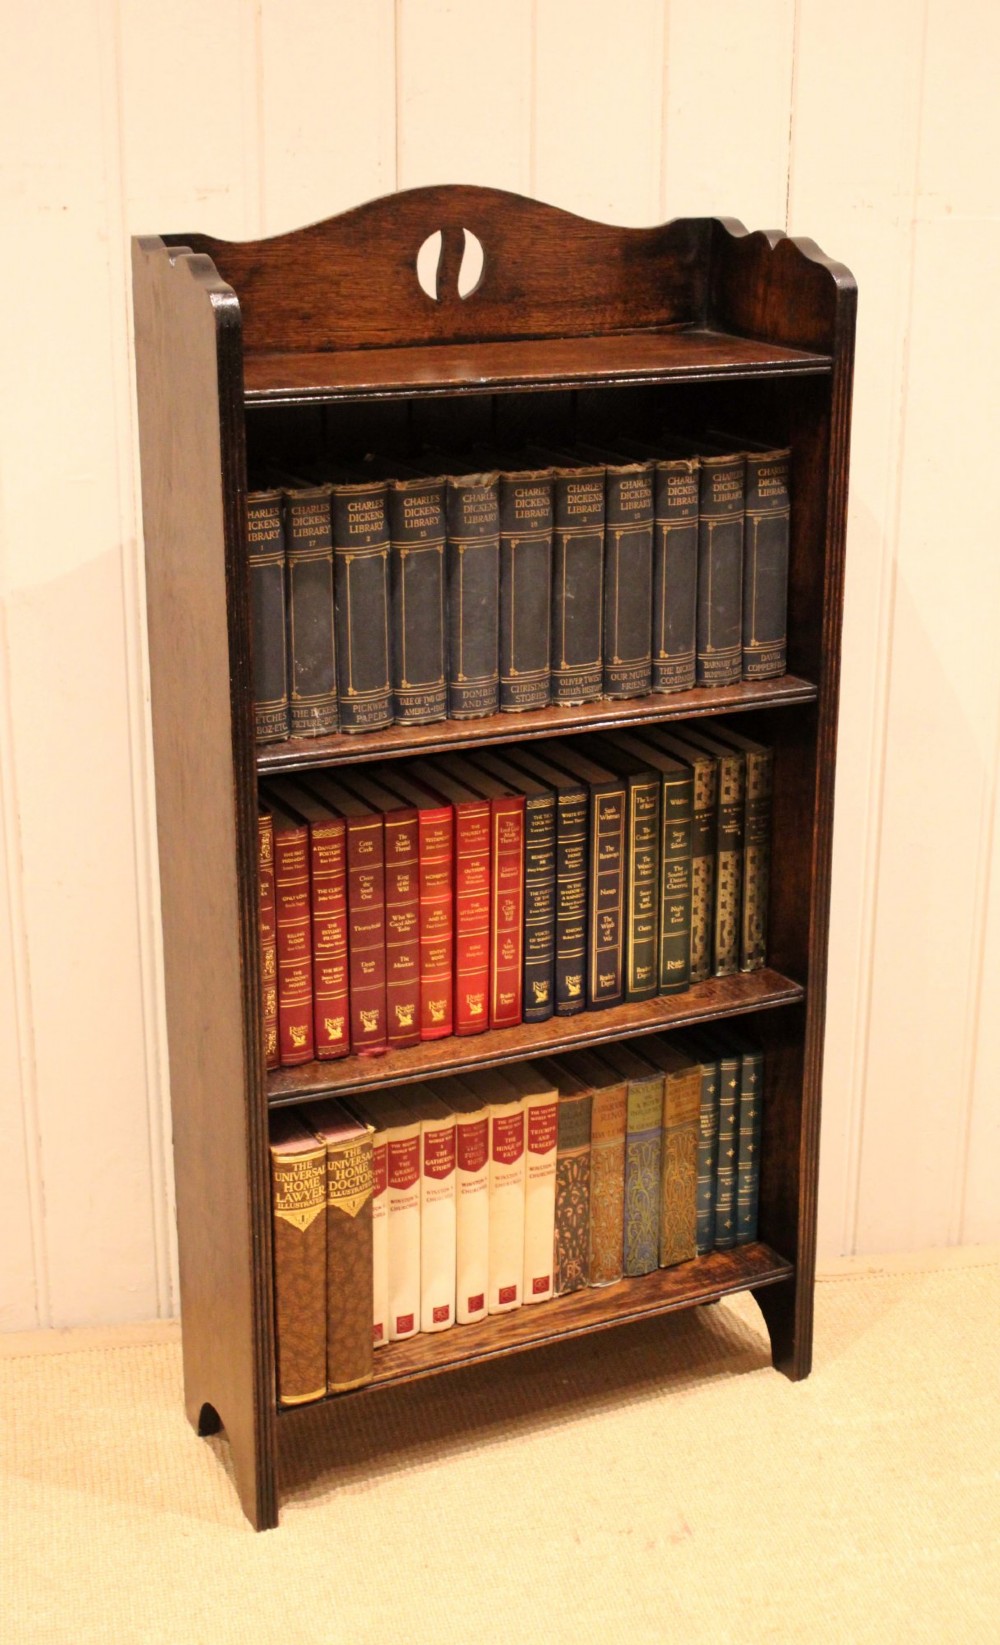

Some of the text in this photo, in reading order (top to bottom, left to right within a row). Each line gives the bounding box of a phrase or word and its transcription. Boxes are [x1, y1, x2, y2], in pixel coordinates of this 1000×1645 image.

[758, 466, 787, 477] CHARL
[668, 476, 696, 486] CHARL
[758, 477, 786, 488] DICKE
[515, 486, 550, 498] CHARLES
[567, 482, 602, 494] CHARLES
[404, 494, 440, 507] CHARLES
[568, 493, 603, 504] DICKENS
[620, 489, 652, 500] DICKENS
[348, 500, 384, 512] CHARLES
[464, 502, 498, 514] DICKENS
[516, 497, 550, 508] DICKENS
[568, 503, 603, 514] LIBRARY
[247, 507, 280, 519] HARLES
[291, 503, 330, 515] CHARLES
[404, 506, 440, 518] DICKENS
[516, 508, 550, 519] LIBRARY
[292, 514, 331, 526] DICKENS
[348, 511, 384, 523] DICKENS
[405, 517, 440, 529] LIBRARY
[464, 512, 498, 524] LIBRARY
[248, 518, 280, 530] ICKENS
[350, 521, 384, 534] LIBRARY
[248, 529, 280, 541] IBRARY
[293, 525, 331, 537] LIBRARY
[611, 672, 628, 680] OUR
[622, 680, 646, 690] FRIEND
[462, 688, 496, 698] DOMBEY
[516, 692, 546, 703] STORIES
[353, 701, 388, 712] PICKWICK
[462, 700, 481, 708] AND
[294, 710, 308, 718] THE
[356, 711, 387, 722] PAPERS
[344, 1147, 362, 1158] THE
[294, 1161, 312, 1172] THE
[328, 1151, 372, 1170] UNIVERSAL
[275, 1164, 326, 1182] UNIVERSAL
[336, 1162, 368, 1180] HOME
[432, 1163, 452, 1172] STORM
[284, 1177, 320, 1192] HOME
[329, 1170, 372, 1191] DOCTOR
[276, 1185, 326, 1203] LAWYER
